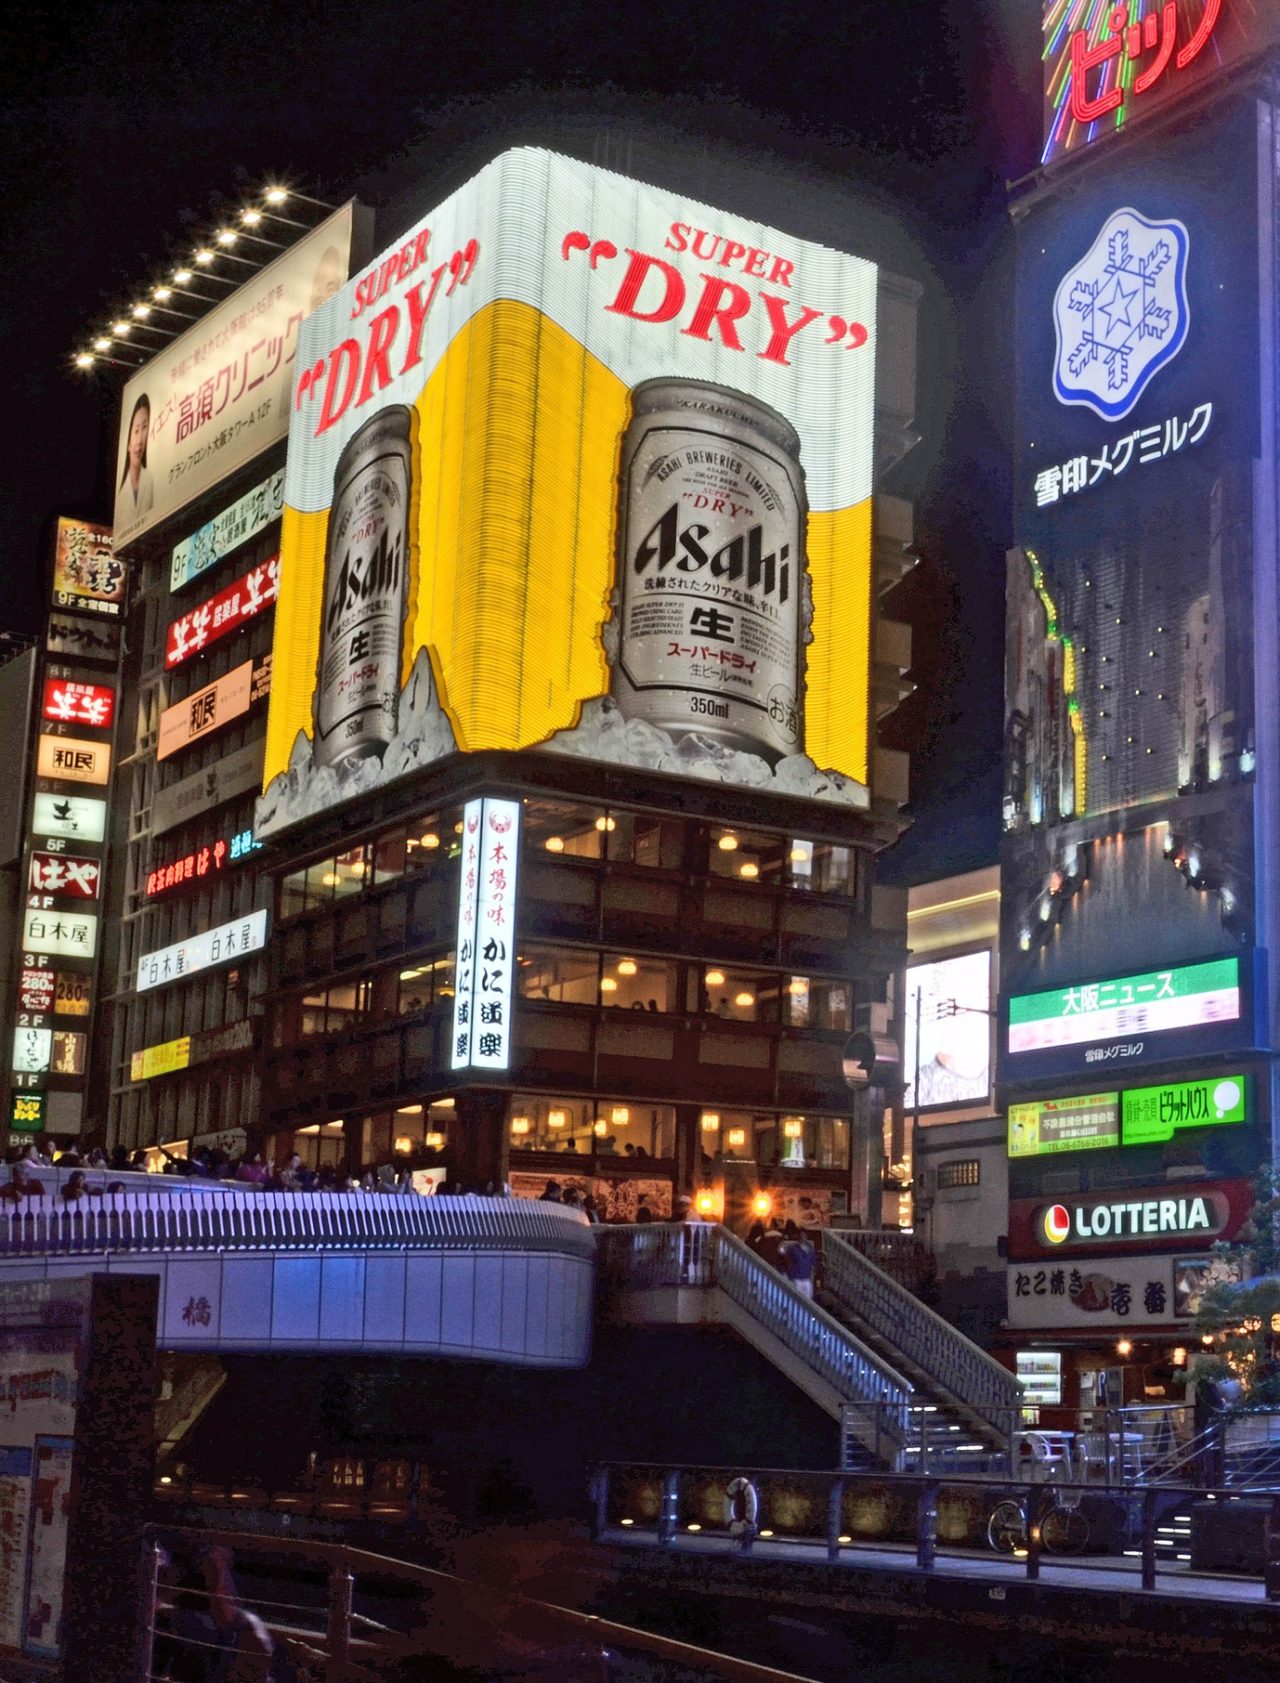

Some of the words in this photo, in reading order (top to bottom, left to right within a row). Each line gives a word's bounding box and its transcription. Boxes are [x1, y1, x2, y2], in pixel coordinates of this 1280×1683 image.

[665, 222, 795, 288] SUPER
[352, 228, 431, 321] SUPER
[176, 309, 304, 444] 高須クリニック
[1034, 402, 1212, 507] 雪印メグミルク
[656, 457, 682, 483] ASAHI
[686, 450, 743, 475] BREWERIES
[745, 471, 776, 512] LIMITED
[634, 502, 790, 605] Asahi
[167, 603, 211, 662] 笑笑
[690, 607, 735, 644] 生
[348, 630, 371, 666] 生
[667, 642, 757, 674] スーパードライ
[690, 663, 732, 682] 生ビール
[46, 689, 110, 724] 笑笑
[191, 693, 216, 731] 和民
[691, 697, 730, 719] 350ml
[55, 749, 93, 769] 和民
[46, 840, 66, 852] 5F
[33, 858, 98, 895] はや
[486, 841, 509, 927] 本場の味
[29, 894, 55, 909] 4F
[28, 917, 90, 945] 白木屋
[24, 954, 49, 968] 3F
[149, 949, 185, 984] 白木屋
[211, 923, 251, 962] 白木屋
[479, 937, 507, 1058] かに道楽
[1062, 972, 1176, 1016] 大阪ニュース
[19, 1013, 44, 1027] 2F
[1084, 1042, 1144, 1063] 雪印メグミルク
[15, 1074, 40, 1087] 1F
[1160, 1086, 1210, 1124] ピタットハウス
[1076, 1197, 1210, 1237] LOTTERIA
[1015, 1268, 1084, 1297] たこ焼き
